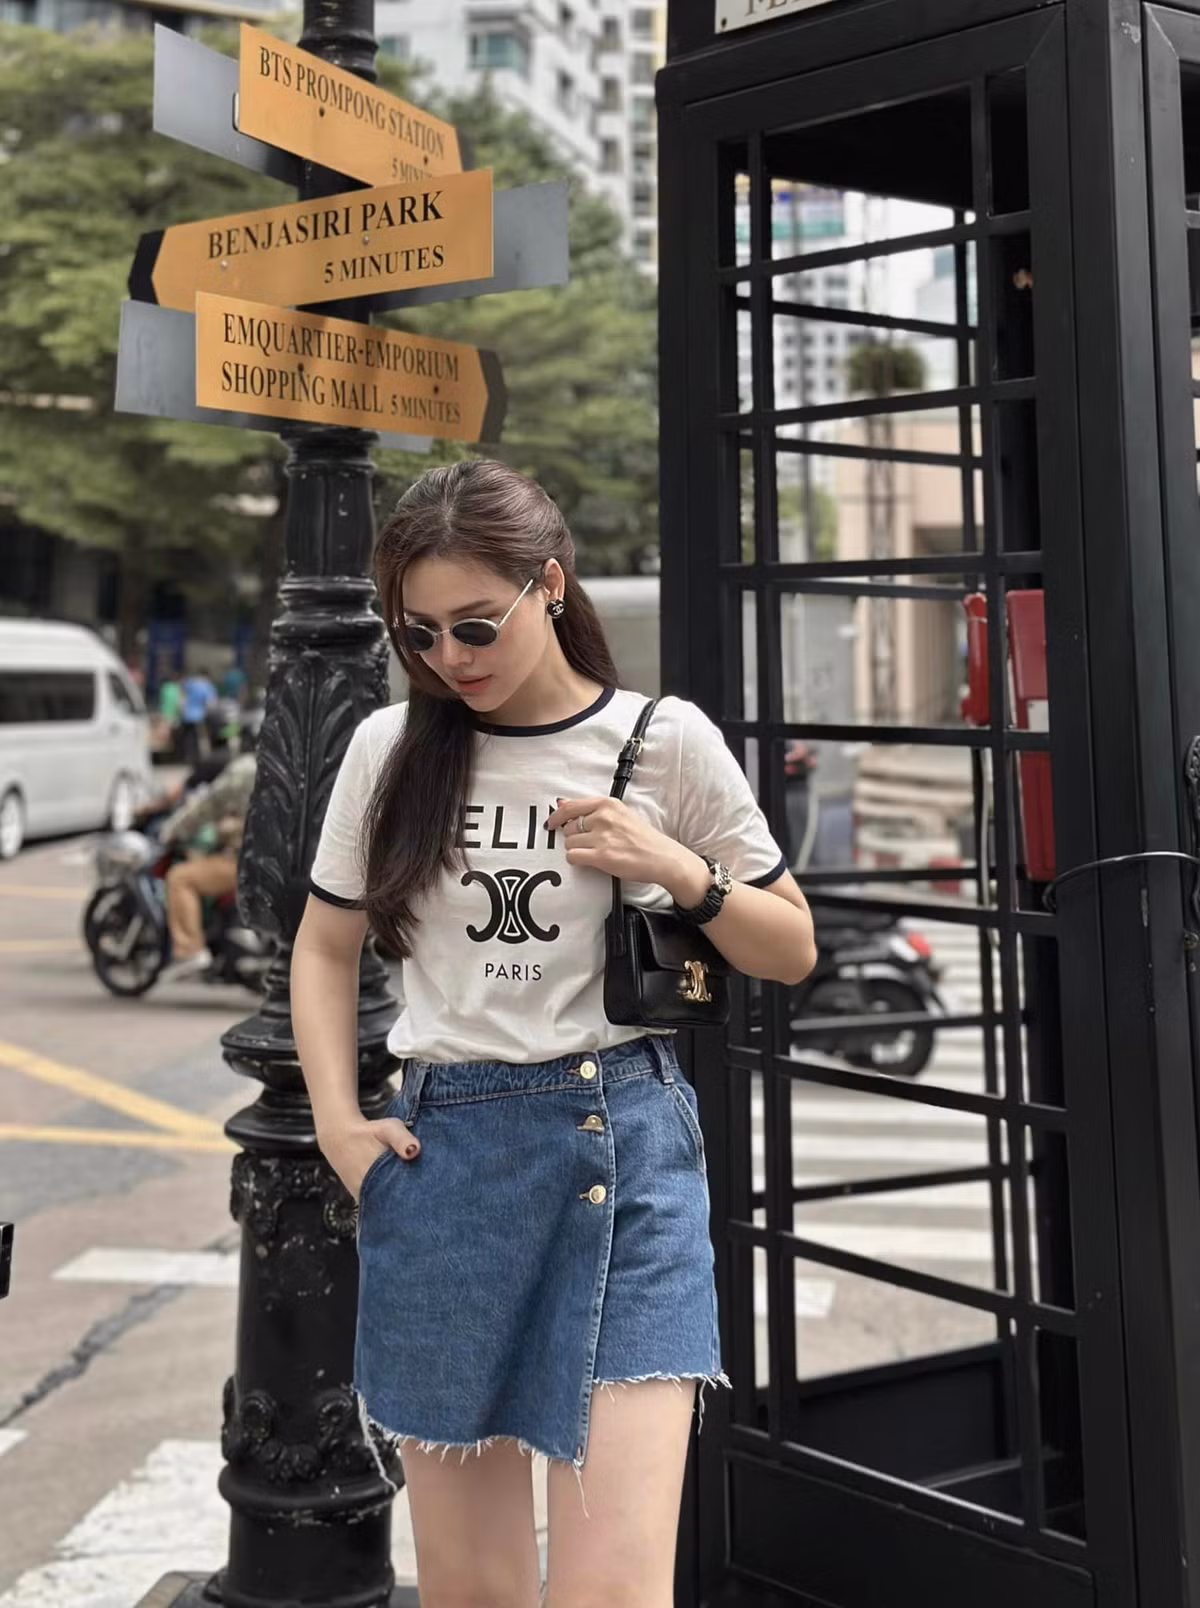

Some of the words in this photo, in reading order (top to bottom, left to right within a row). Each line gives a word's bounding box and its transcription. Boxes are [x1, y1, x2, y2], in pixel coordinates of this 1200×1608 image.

[259, 46, 292, 87] BTS
[296, 63, 386, 130] PROMPONG
[388, 108, 445, 159] STATION
[392, 157, 398, 179] 5
[208, 206, 351, 260] BENJASIRI
[361, 190, 444, 231] PARK
[324, 262, 334, 284] 5
[339, 245, 445, 282] MINUTES
[221, 361, 325, 406] SHOPPING
[331, 379, 383, 414] MALL
[391, 395, 398, 415] 5
[401, 396, 461, 425] MINUTES
[485, 963, 542, 981] PARIS
